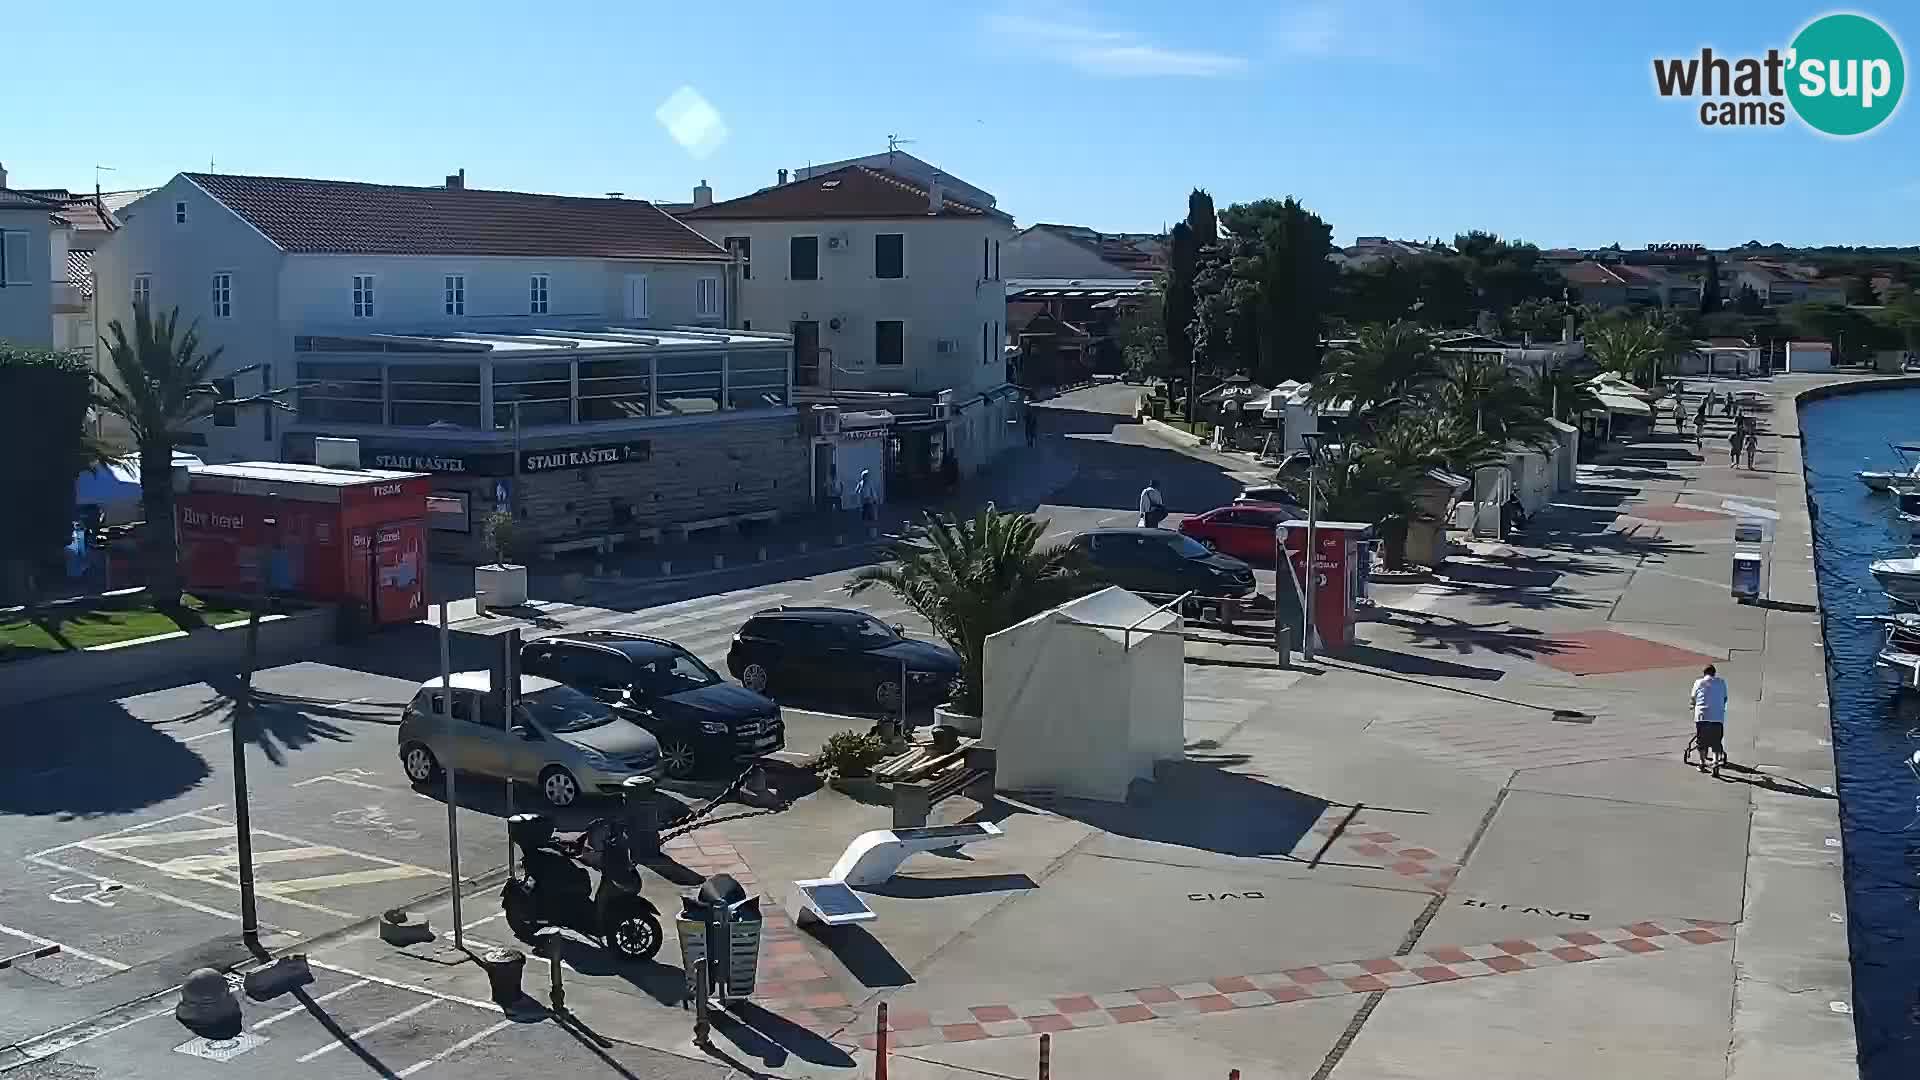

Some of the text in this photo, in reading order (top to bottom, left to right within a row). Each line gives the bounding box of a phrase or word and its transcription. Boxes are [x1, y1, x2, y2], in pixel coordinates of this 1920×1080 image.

[527, 447, 619, 470] STARI KAŠTEL
[373, 484, 402, 497] TISAK
[353, 533, 373, 548] Buy
